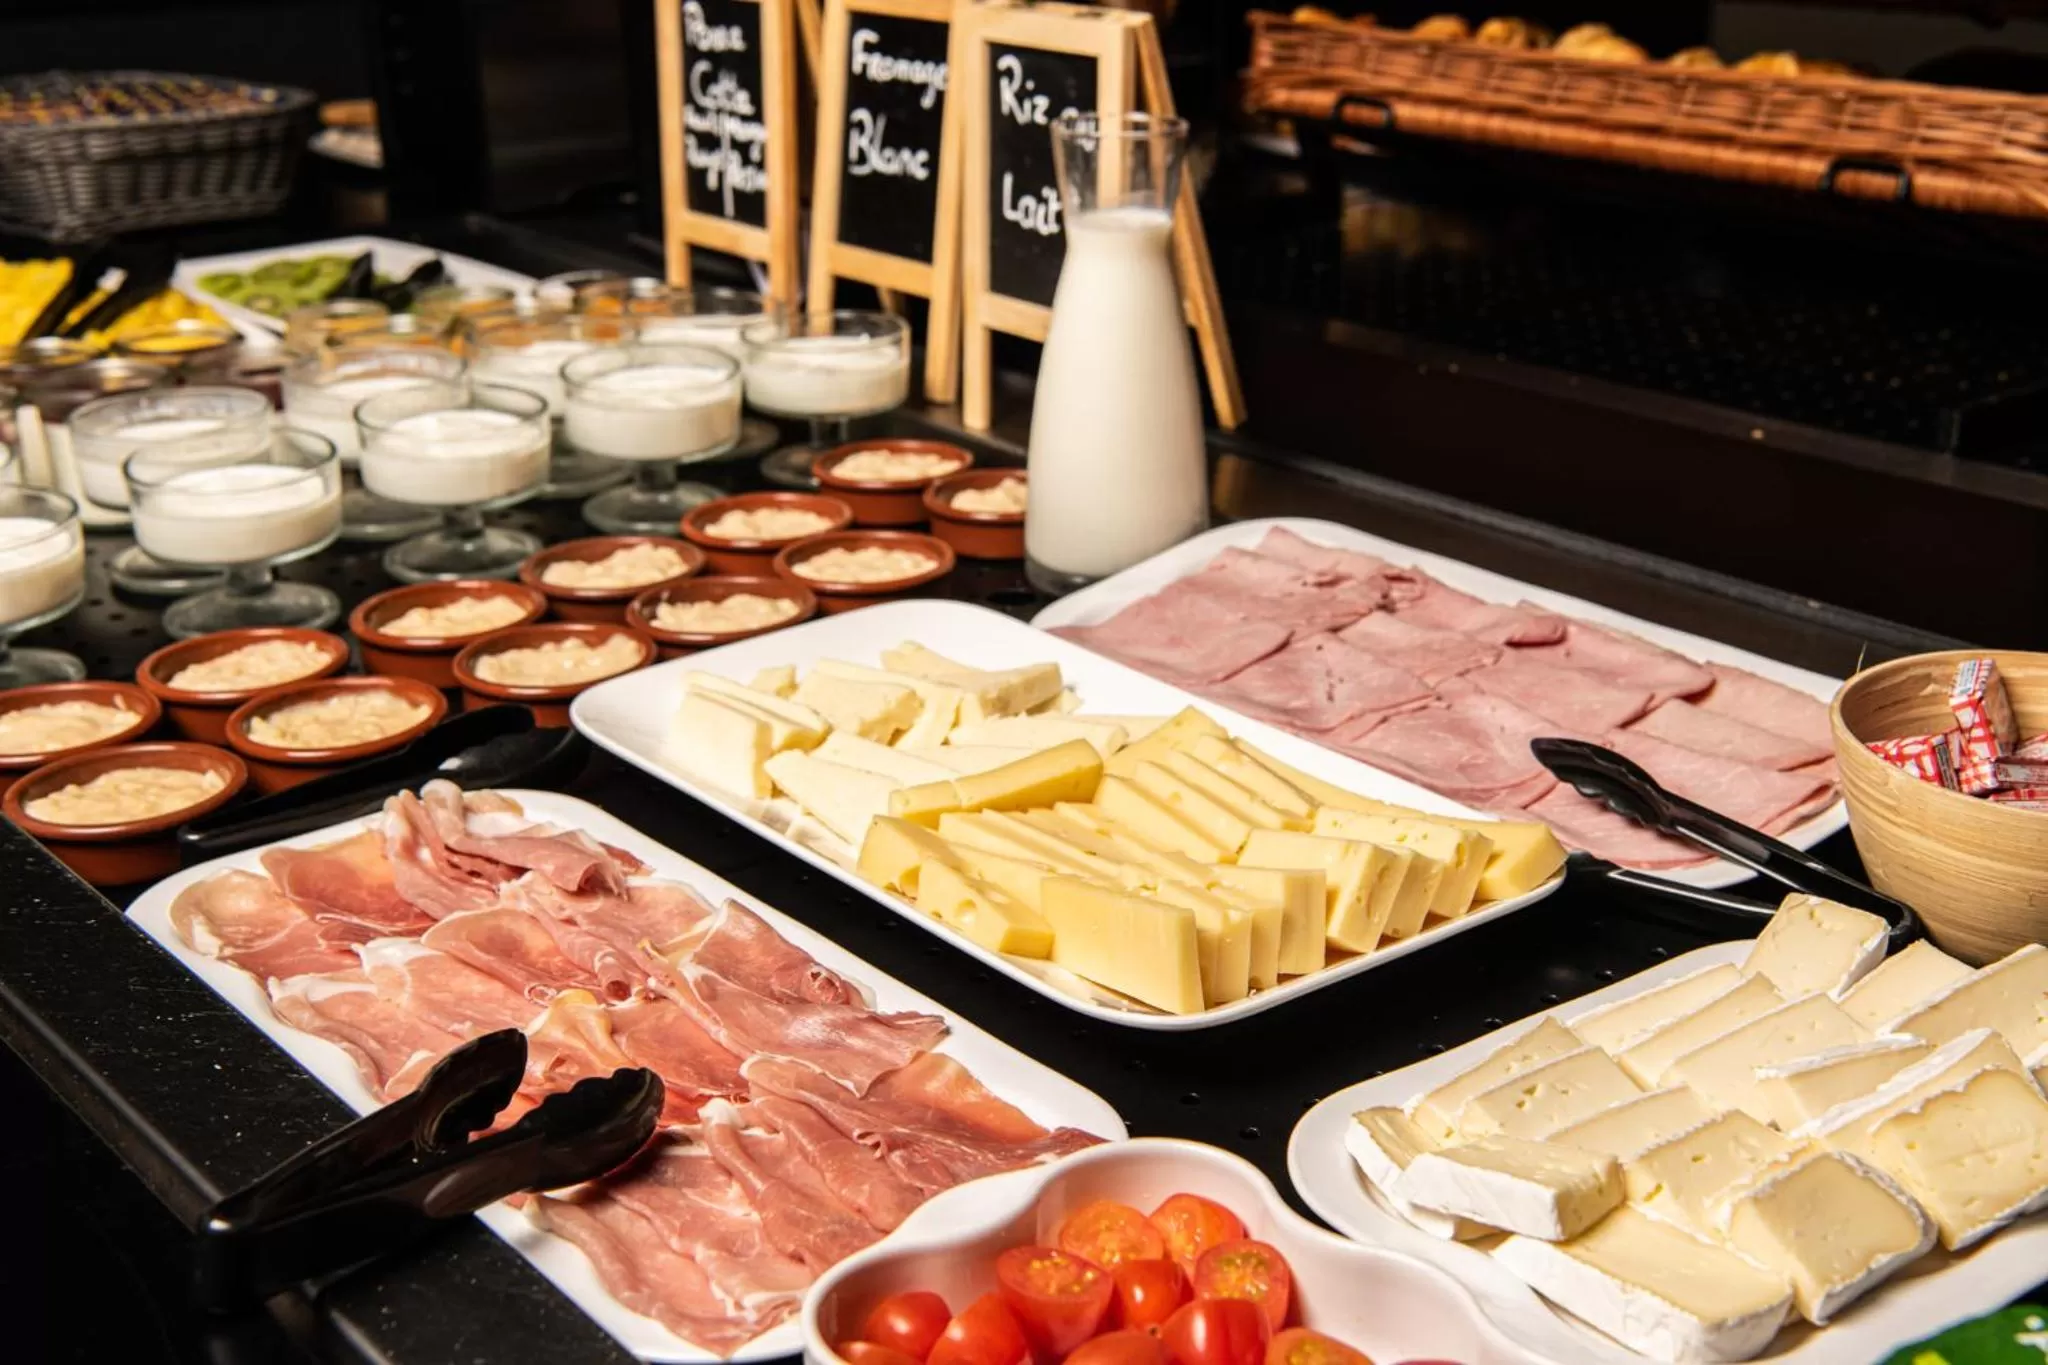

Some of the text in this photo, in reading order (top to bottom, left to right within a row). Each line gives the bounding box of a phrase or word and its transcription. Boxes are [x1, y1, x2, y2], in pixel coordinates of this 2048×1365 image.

[997, 54, 1050, 126] Riz
[849, 107, 930, 181] Blanc
[1003, 171, 1062, 236] Lait
